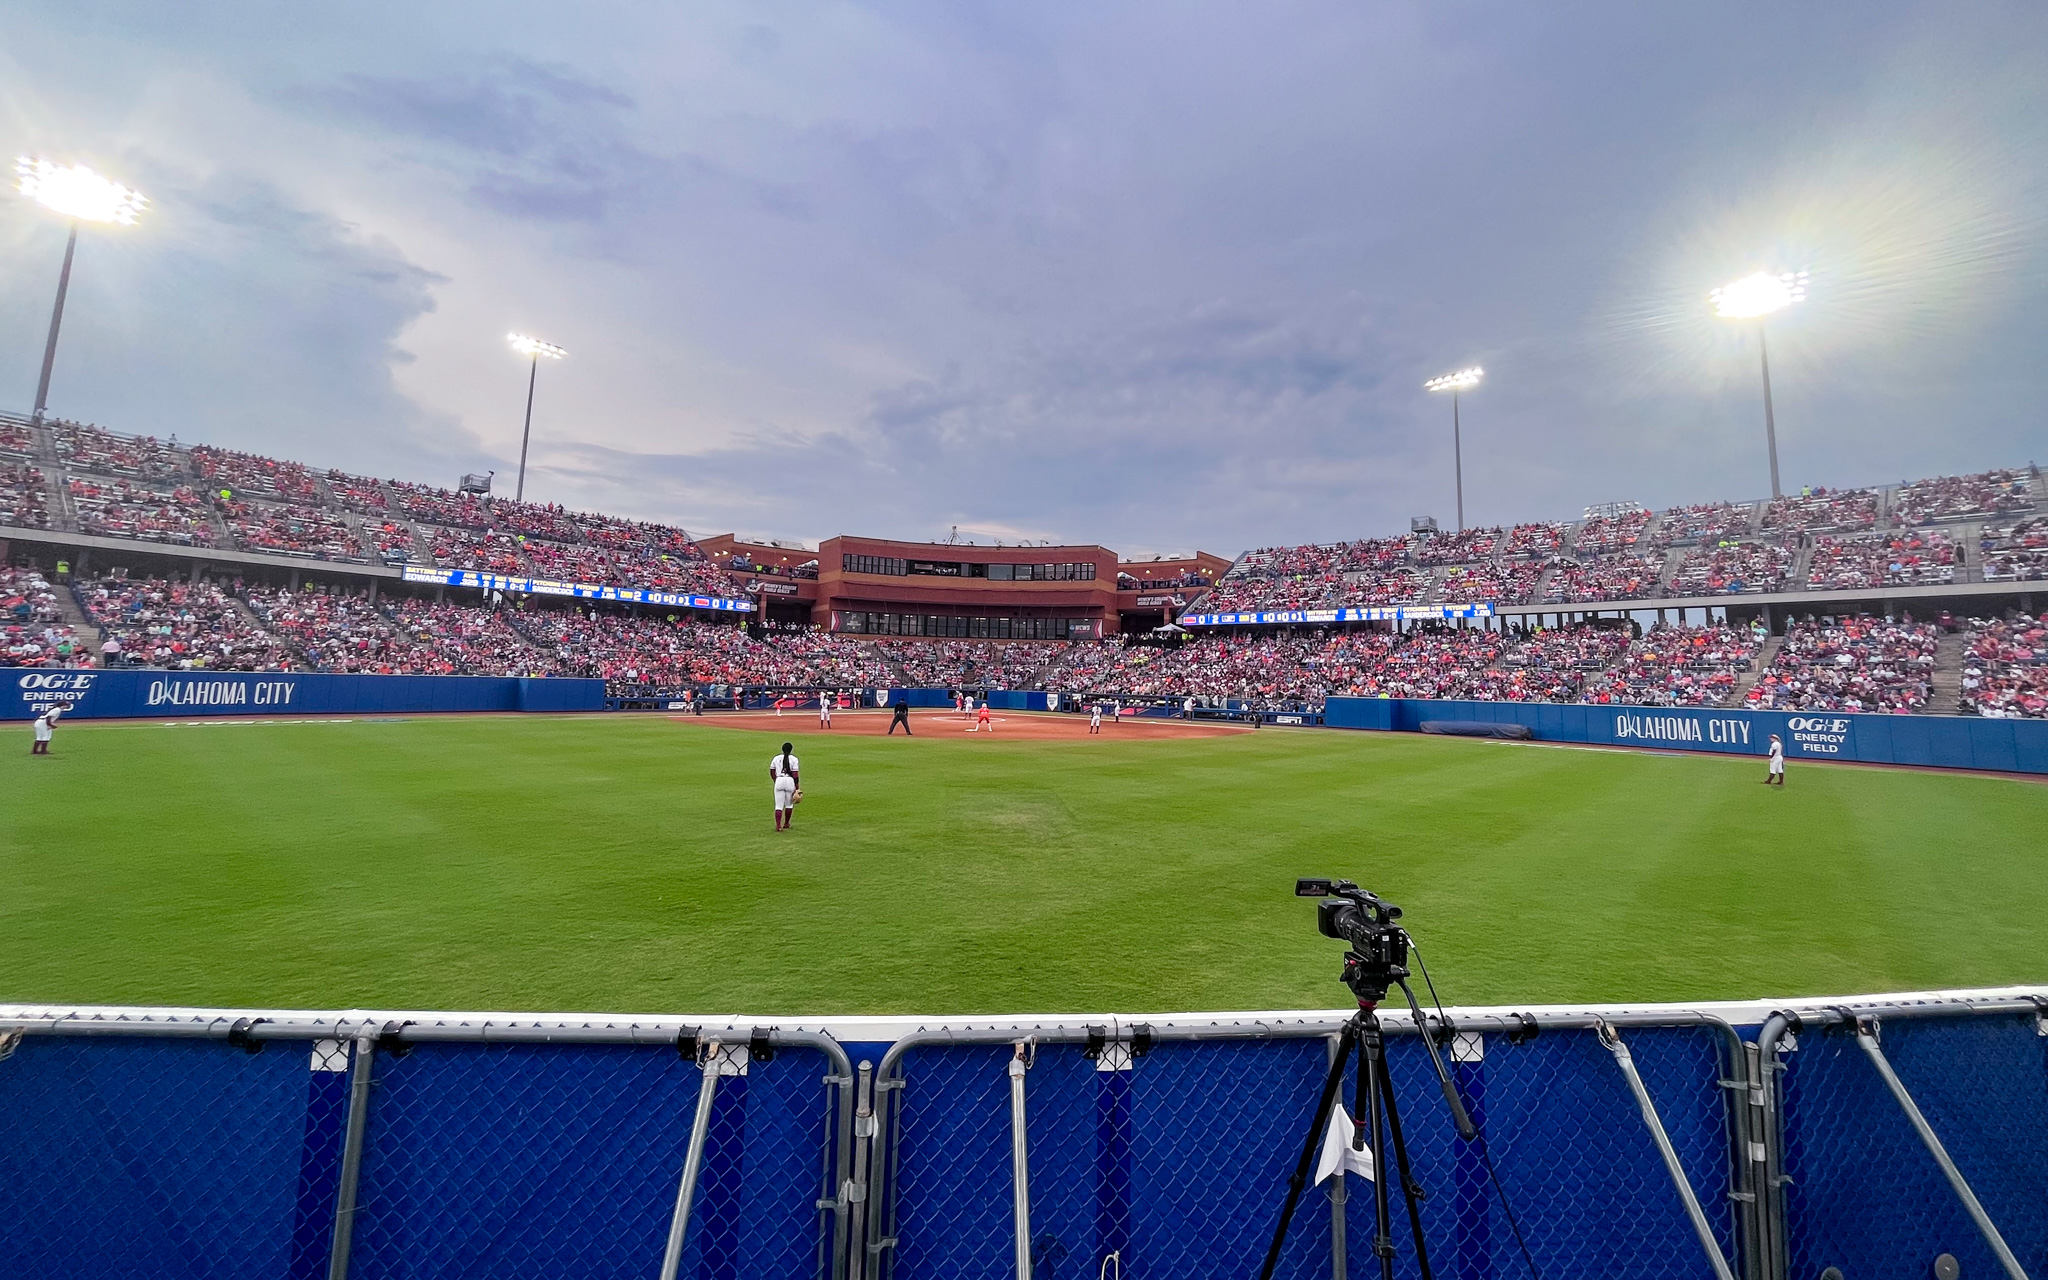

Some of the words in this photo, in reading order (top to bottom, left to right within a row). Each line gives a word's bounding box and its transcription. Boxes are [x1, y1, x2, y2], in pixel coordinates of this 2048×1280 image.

[405, 573, 448, 584] EDWARDS
[23, 691, 86, 701] ENERGY
[146, 676, 246, 706] OKLAHOMA
[254, 682, 295, 705] CITY
[1277, 715, 1302, 724] ESPN
[1616, 711, 1702, 742] OKLAHOMA
[1709, 719, 1750, 744] CITY
[1794, 732, 1845, 743] ENERGY
[1803, 743, 1838, 753] FIELD
